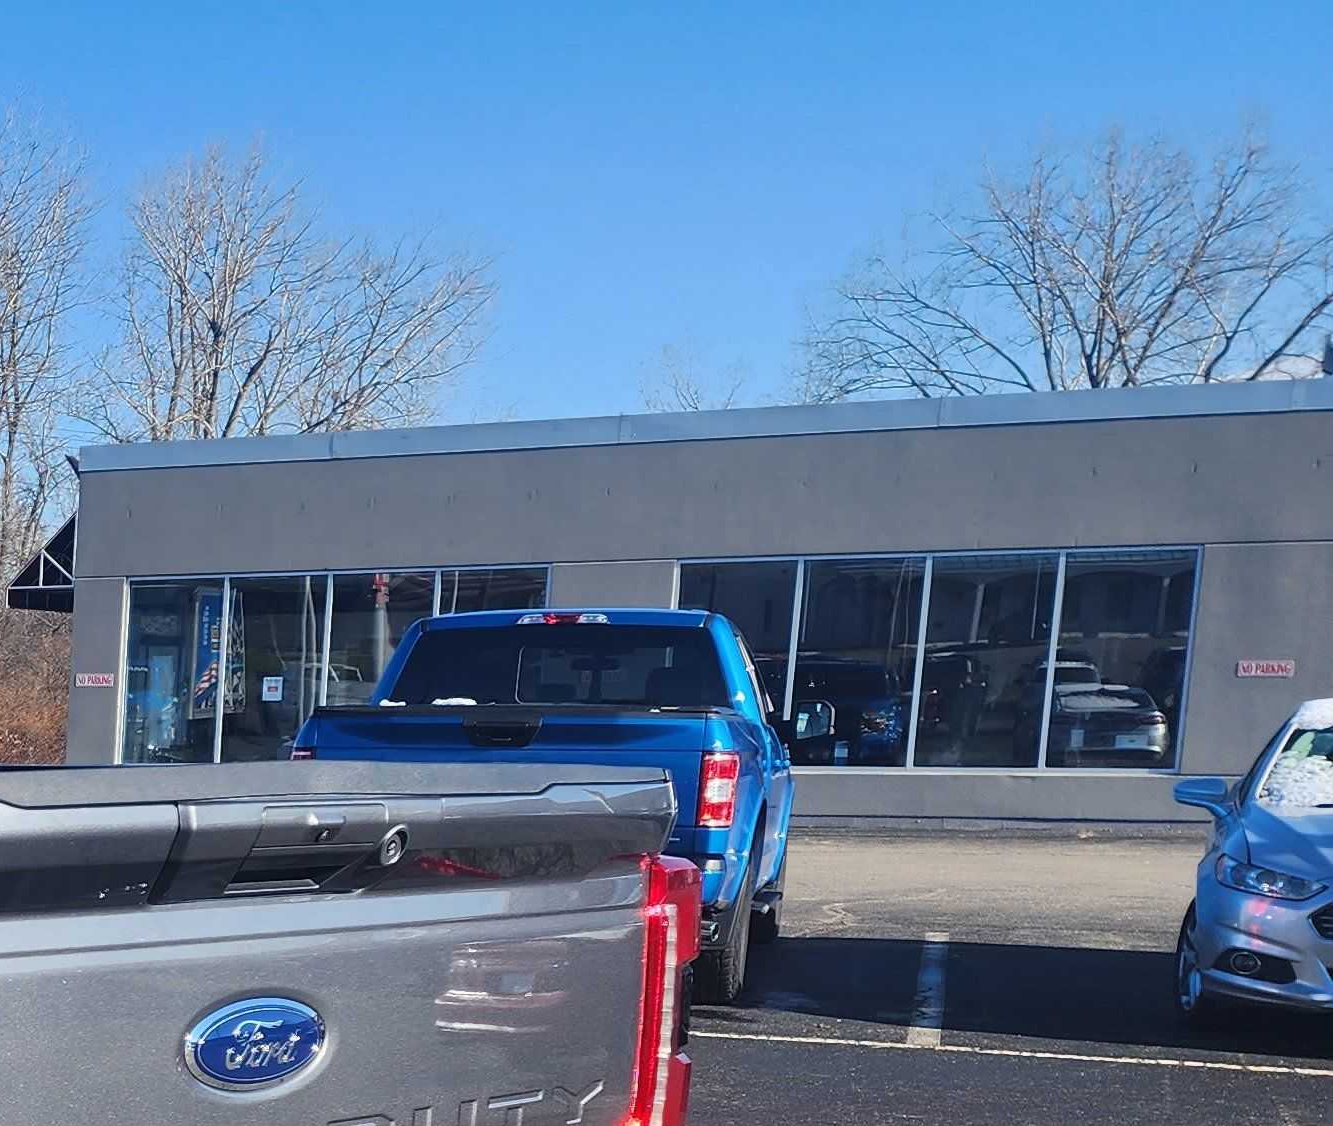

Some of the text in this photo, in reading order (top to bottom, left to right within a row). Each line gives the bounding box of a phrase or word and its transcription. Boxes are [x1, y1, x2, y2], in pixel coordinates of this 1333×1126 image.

[1242, 663, 1291, 674] NO PARKING
[225, 1019, 302, 1070] Ford
